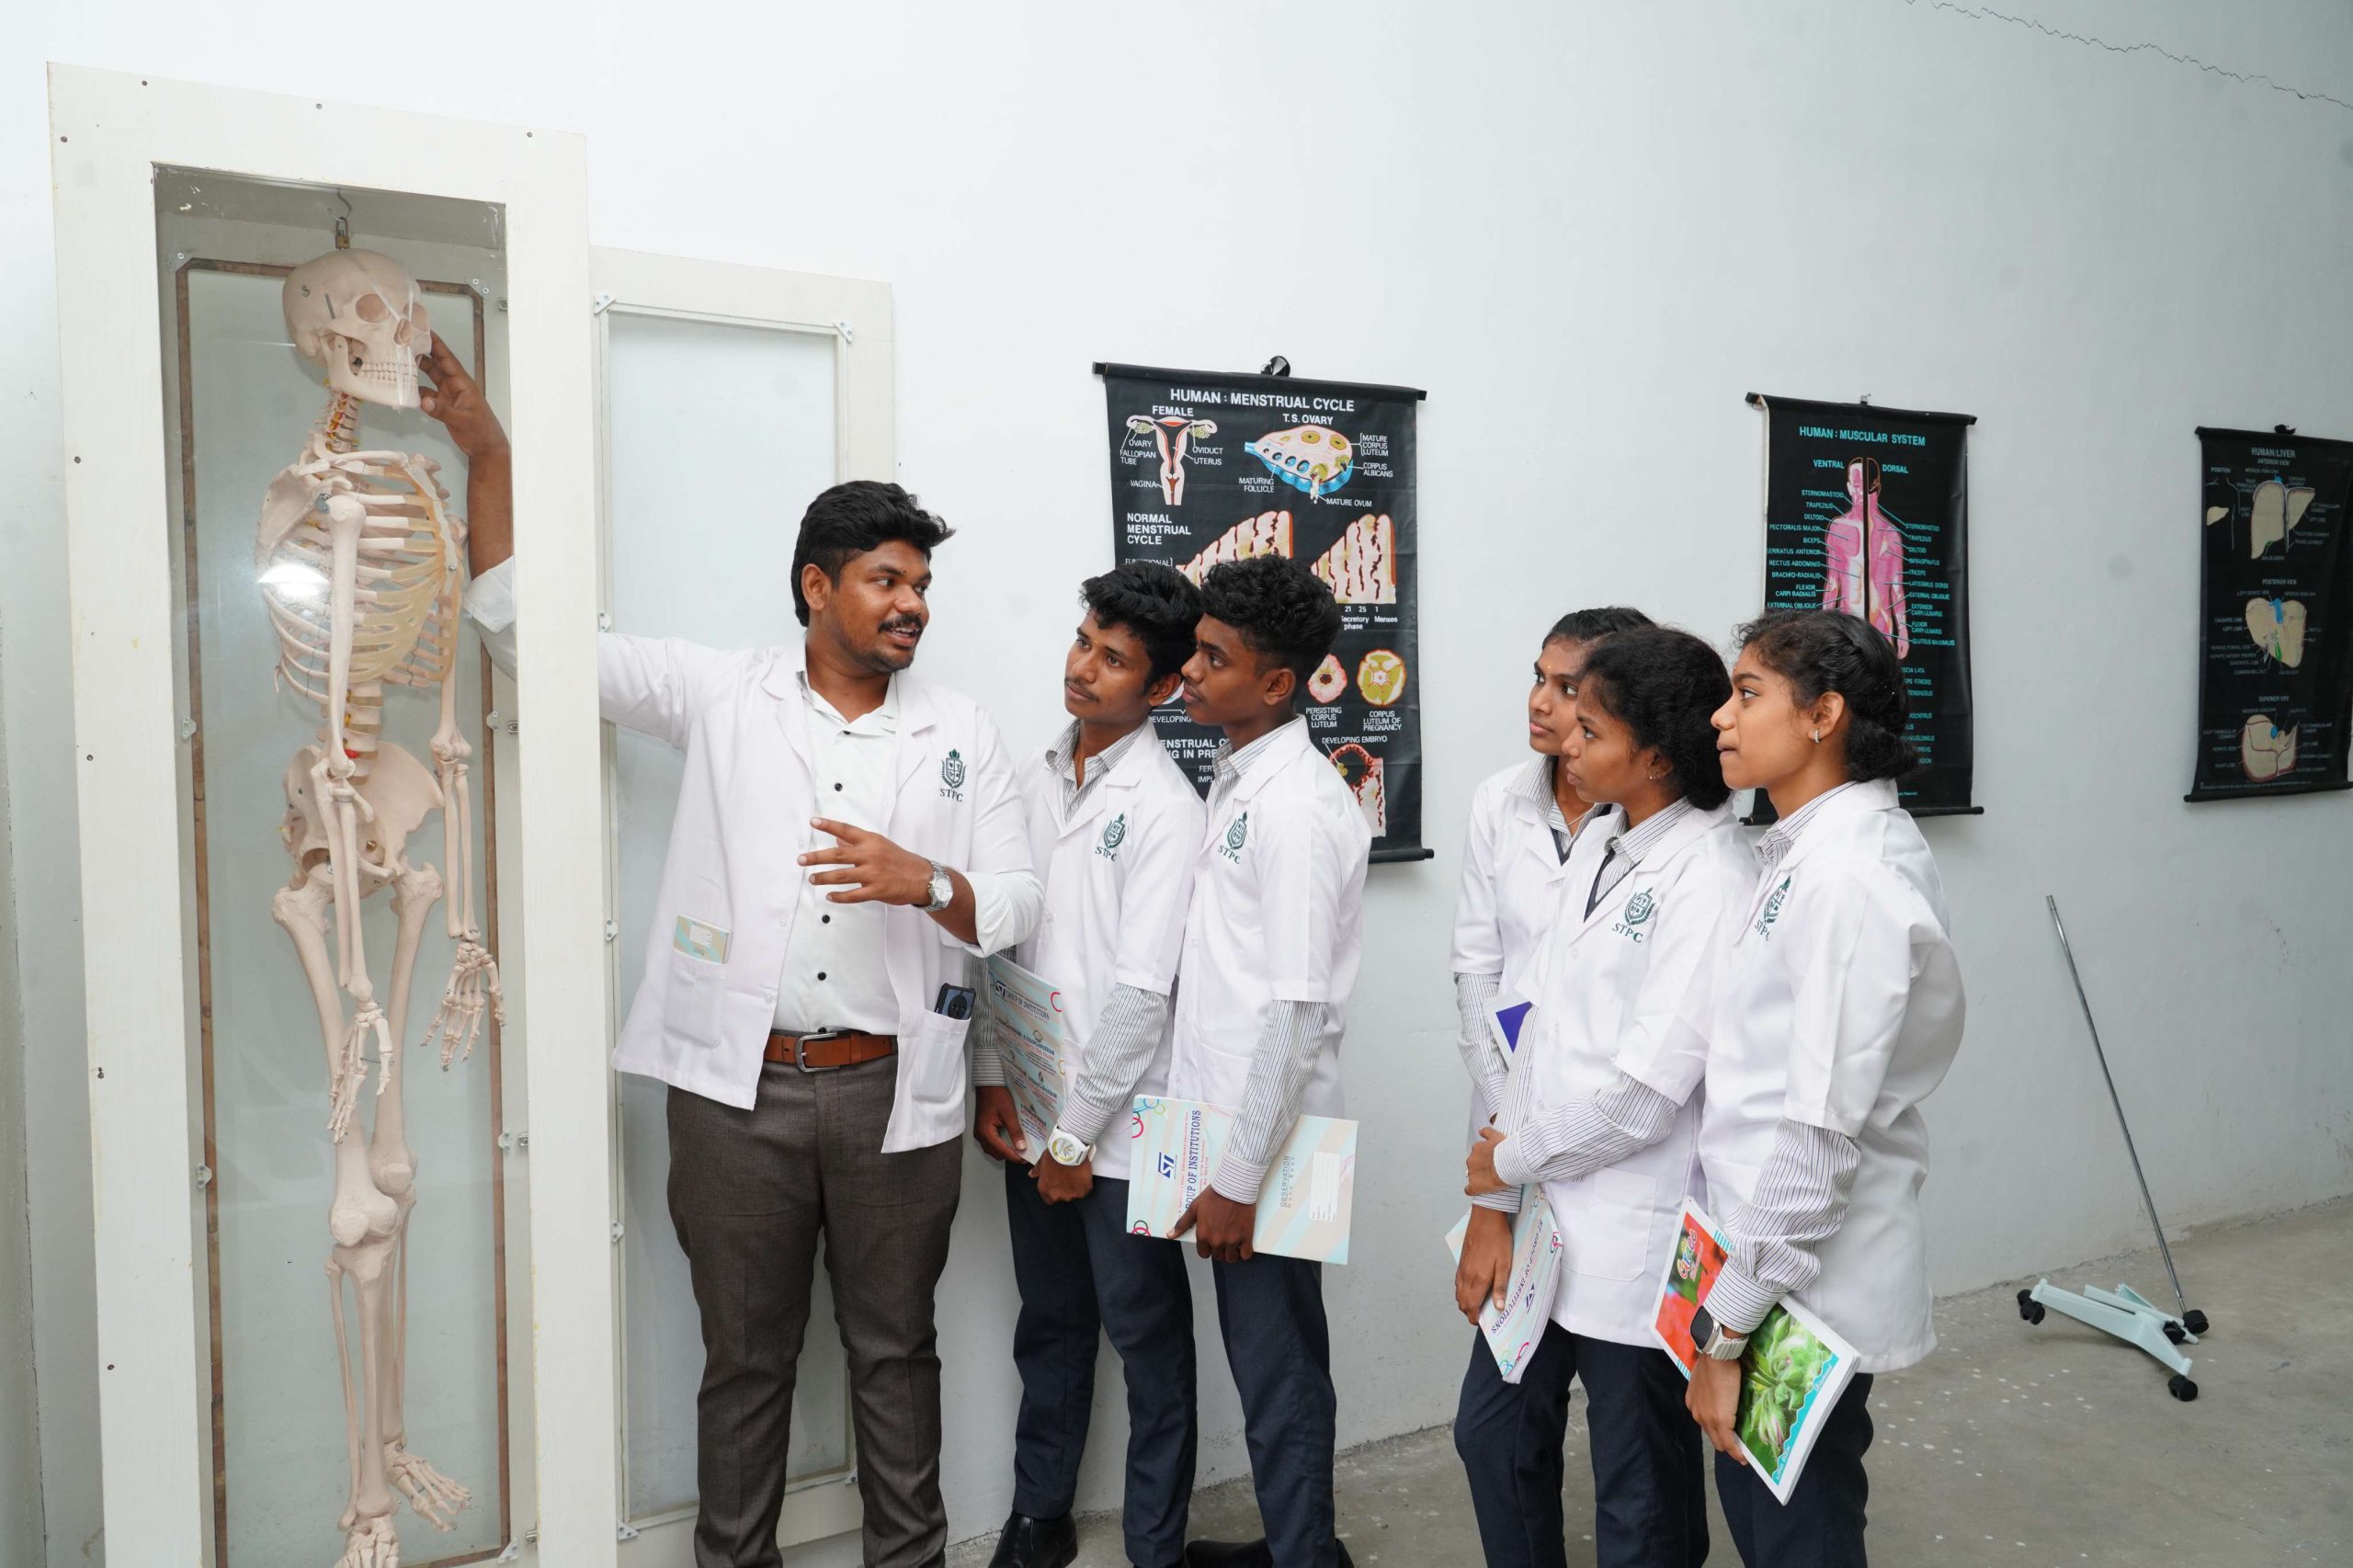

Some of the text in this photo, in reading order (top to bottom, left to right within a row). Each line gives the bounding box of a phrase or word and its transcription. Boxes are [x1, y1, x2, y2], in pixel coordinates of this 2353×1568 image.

[1170, 388, 1221, 403] HUMAN
[1230, 392, 1310, 408] MENSTRUAL
[1313, 399, 1355, 412] CYCLE
[1152, 405, 1194, 417] FEMALE
[1302, 415, 1333, 425] OVARY
[1362, 434, 1388, 443] MATURE
[1799, 426, 1834, 439] HUMAN
[1839, 429, 1888, 443] MUSCULAR
[1892, 434, 1927, 446] SYSTEM
[1120, 449, 1156, 459] FALLOPIAN
[1192, 447, 1223, 455] OVIDUCT
[1120, 456, 1138, 465] TUBE
[1193, 457, 1222, 465] UTERUS
[1813, 460, 1845, 469] VENTRAL
[1363, 461, 1387, 471] CORPUS
[1881, 463, 1908, 474] DORSAL
[1363, 469, 1393, 478] ALBICANS
[1131, 480, 1157, 488] VAGINA
[1326, 498, 1353, 506] MATURE
[1127, 513, 1173, 524] NORMAL
[1127, 524, 1191, 535] MENSTRUAL
[1127, 535, 1162, 545] CYCLE
[1148, 715, 1191, 723] EVELOPING
[1322, 735, 1360, 744] DEVELOPING
[1183, 749, 1195, 759] IN
[939, 789, 963, 801] STPC
[1095, 846, 1117, 862] STPC
[1217, 845, 1241, 865] STPC
[1612, 923, 1643, 943] STPC
[1186, 1110, 1200, 1209] ROUP OF INSTITUTIONS
[1280, 1155, 1290, 1208] OBSERVATION
